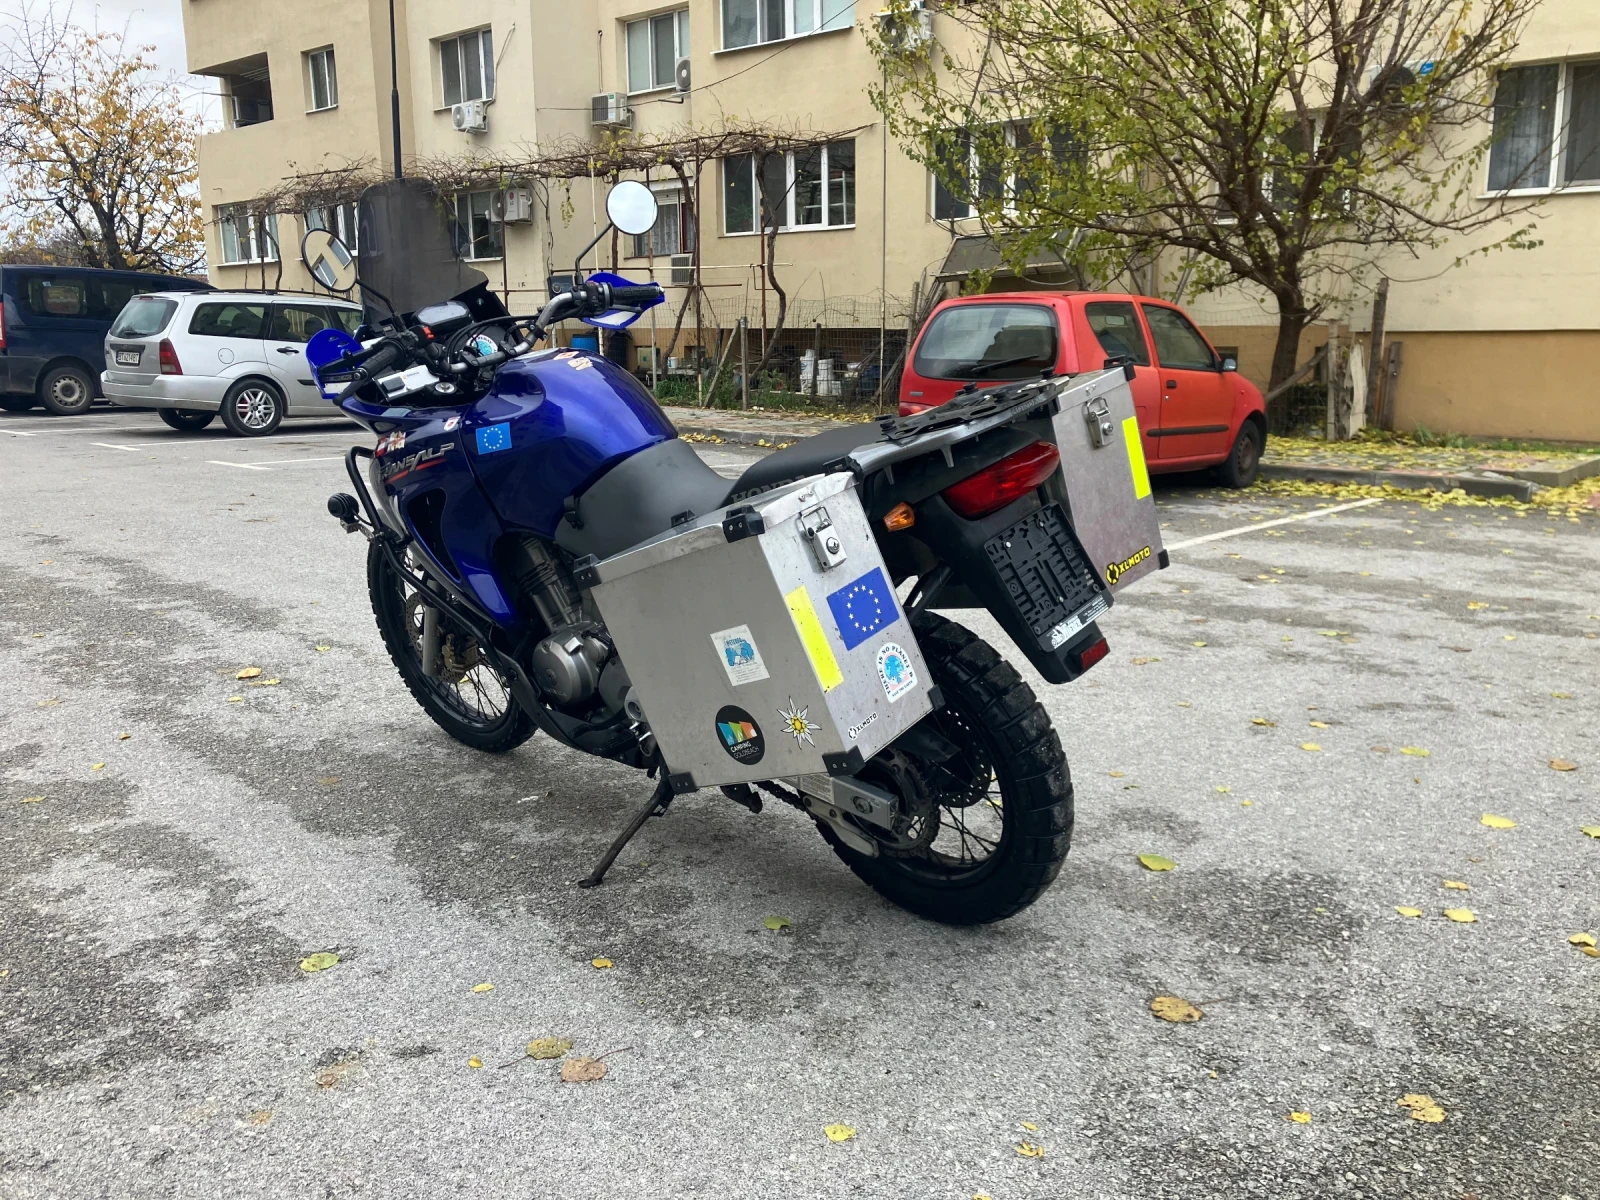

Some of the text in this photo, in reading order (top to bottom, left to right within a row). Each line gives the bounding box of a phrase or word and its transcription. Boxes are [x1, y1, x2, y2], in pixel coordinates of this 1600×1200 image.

[377, 442, 455, 482] TRANSALP
[731, 475, 806, 504] HON
[1118, 546, 1151, 574] XLMOTO
[881, 645, 891, 655] NO
[891, 645, 911, 669] PLANET
[856, 712, 878, 732] XLMOTO
[730, 741, 752, 753] CAMPING
